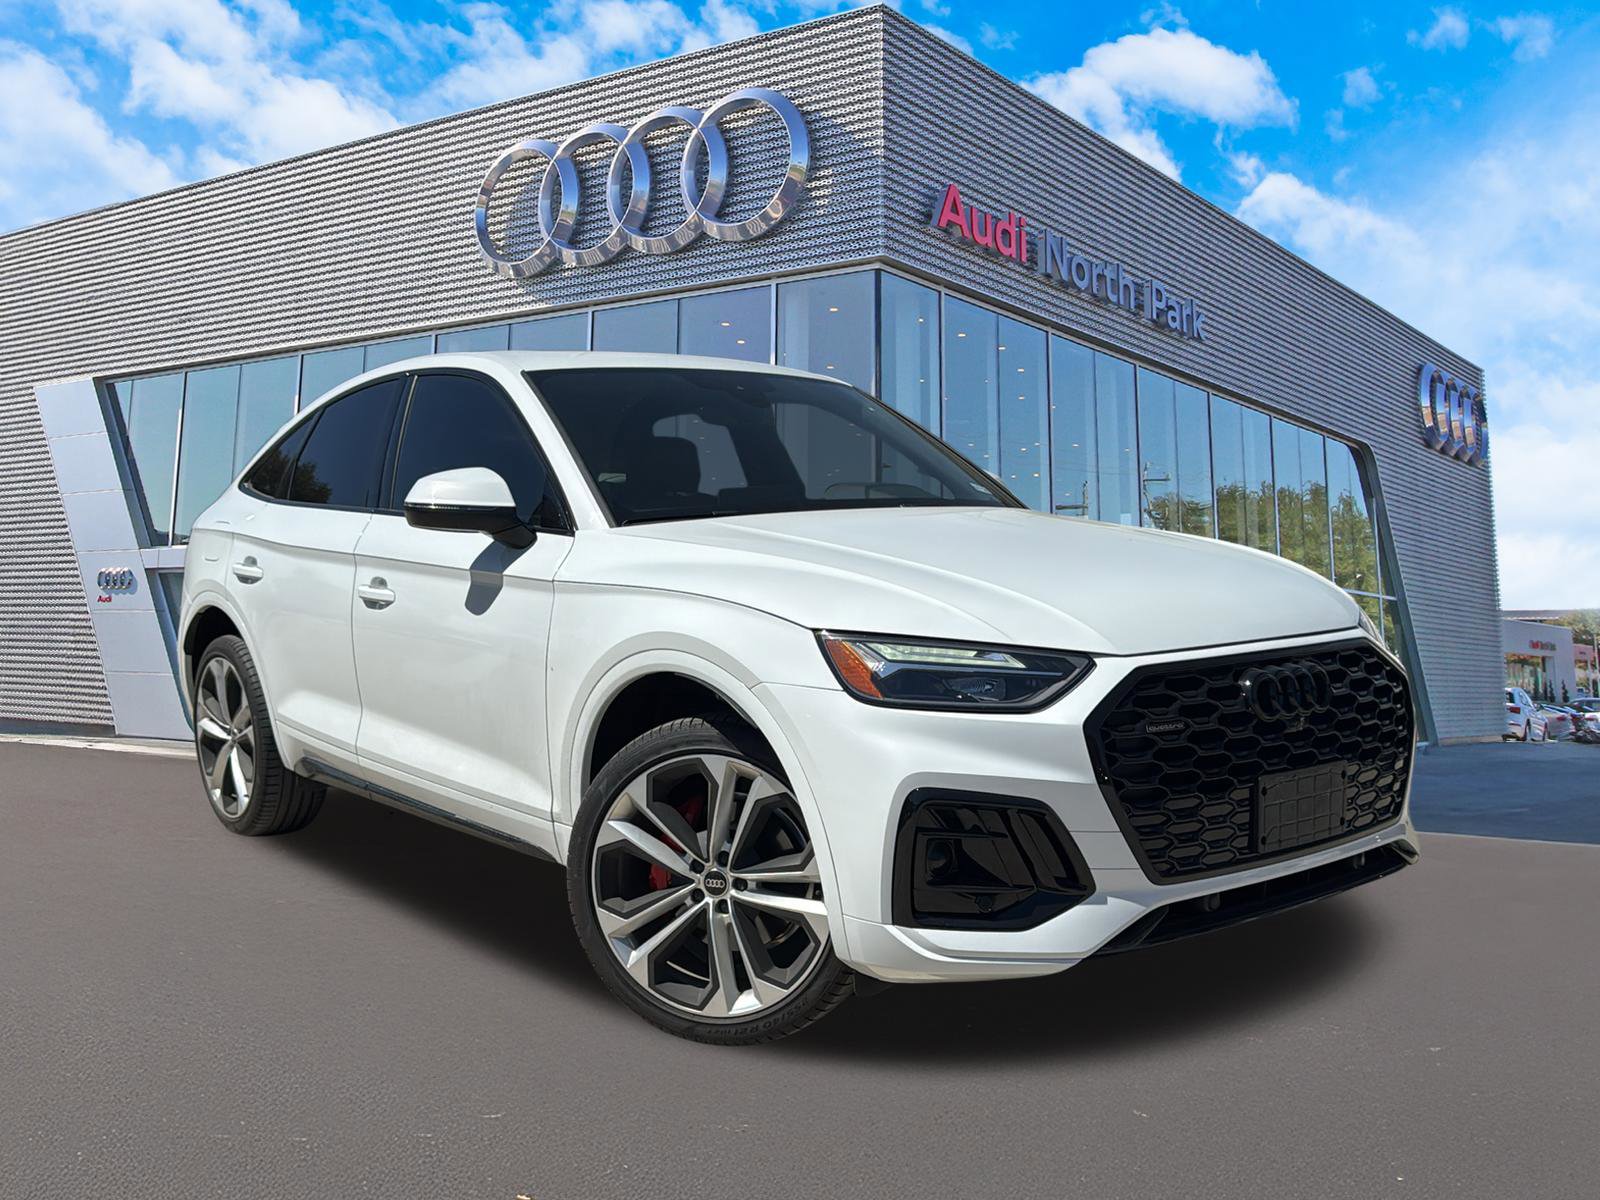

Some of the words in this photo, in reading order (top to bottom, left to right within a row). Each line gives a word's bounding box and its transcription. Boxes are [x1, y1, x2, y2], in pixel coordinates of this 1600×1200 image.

[935, 183, 1028, 264] Audi
[1040, 229, 1136, 311] North
[1147, 278, 1206, 341] Park
[97, 595, 112, 603] Audi
